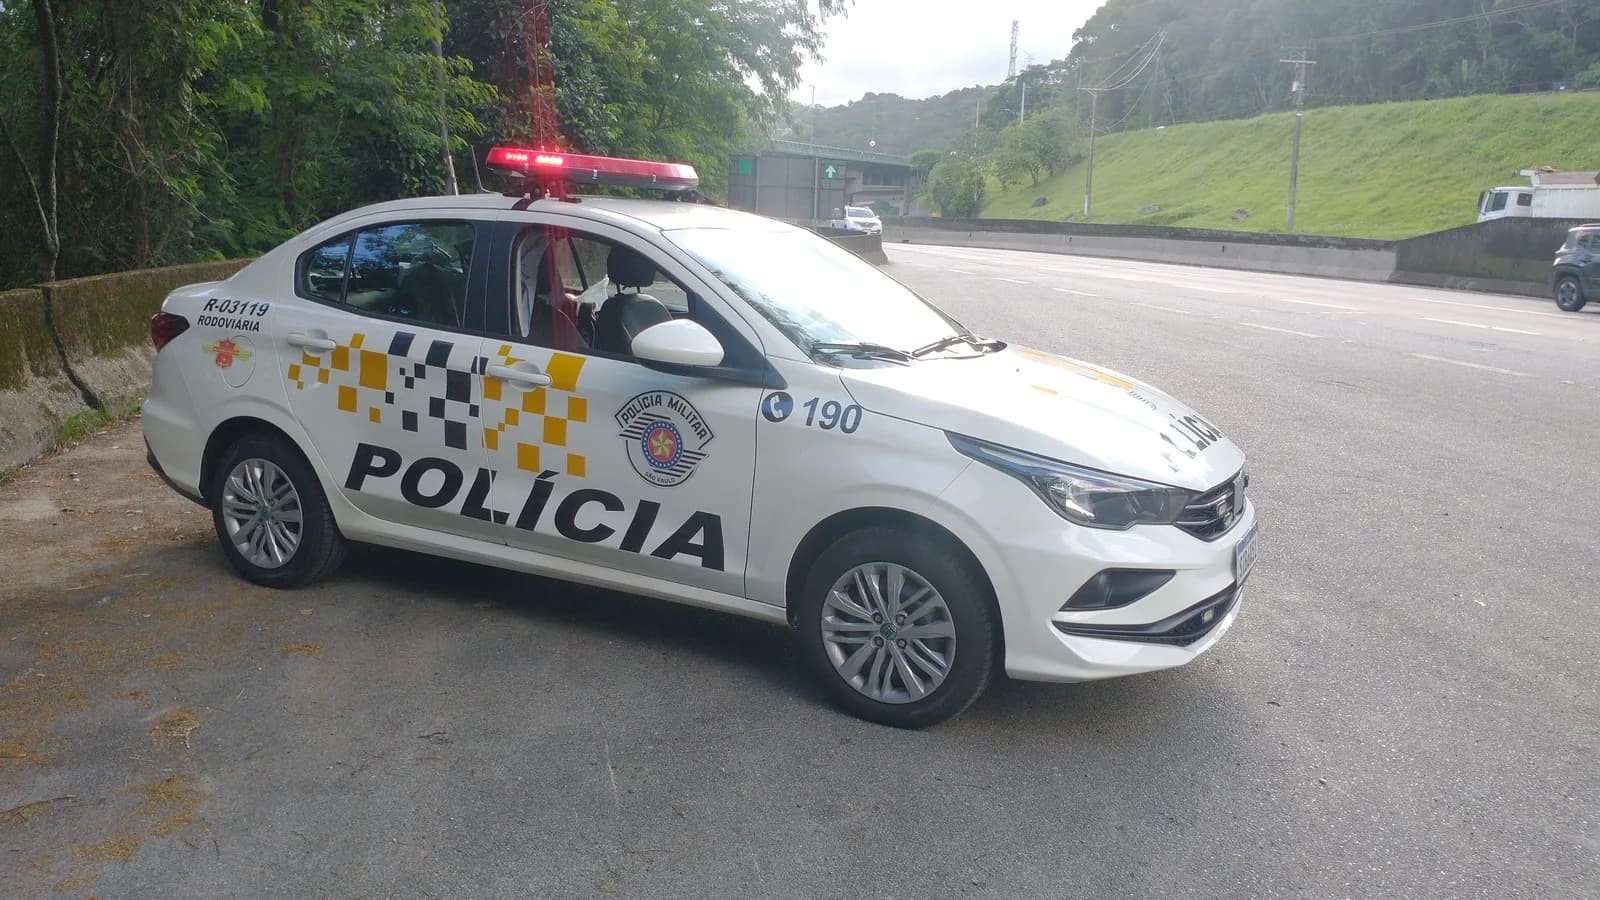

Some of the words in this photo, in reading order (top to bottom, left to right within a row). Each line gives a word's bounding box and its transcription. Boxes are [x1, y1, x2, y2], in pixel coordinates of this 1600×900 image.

[197, 315, 260, 332] RODOVIÁRIA
[203, 298, 270, 317] R-03119
[621, 393, 662, 424] POLÍCIA
[667, 397, 708, 440] MILITAR
[802, 396, 862, 434] 190
[344, 442, 725, 572] POLÍCIA
